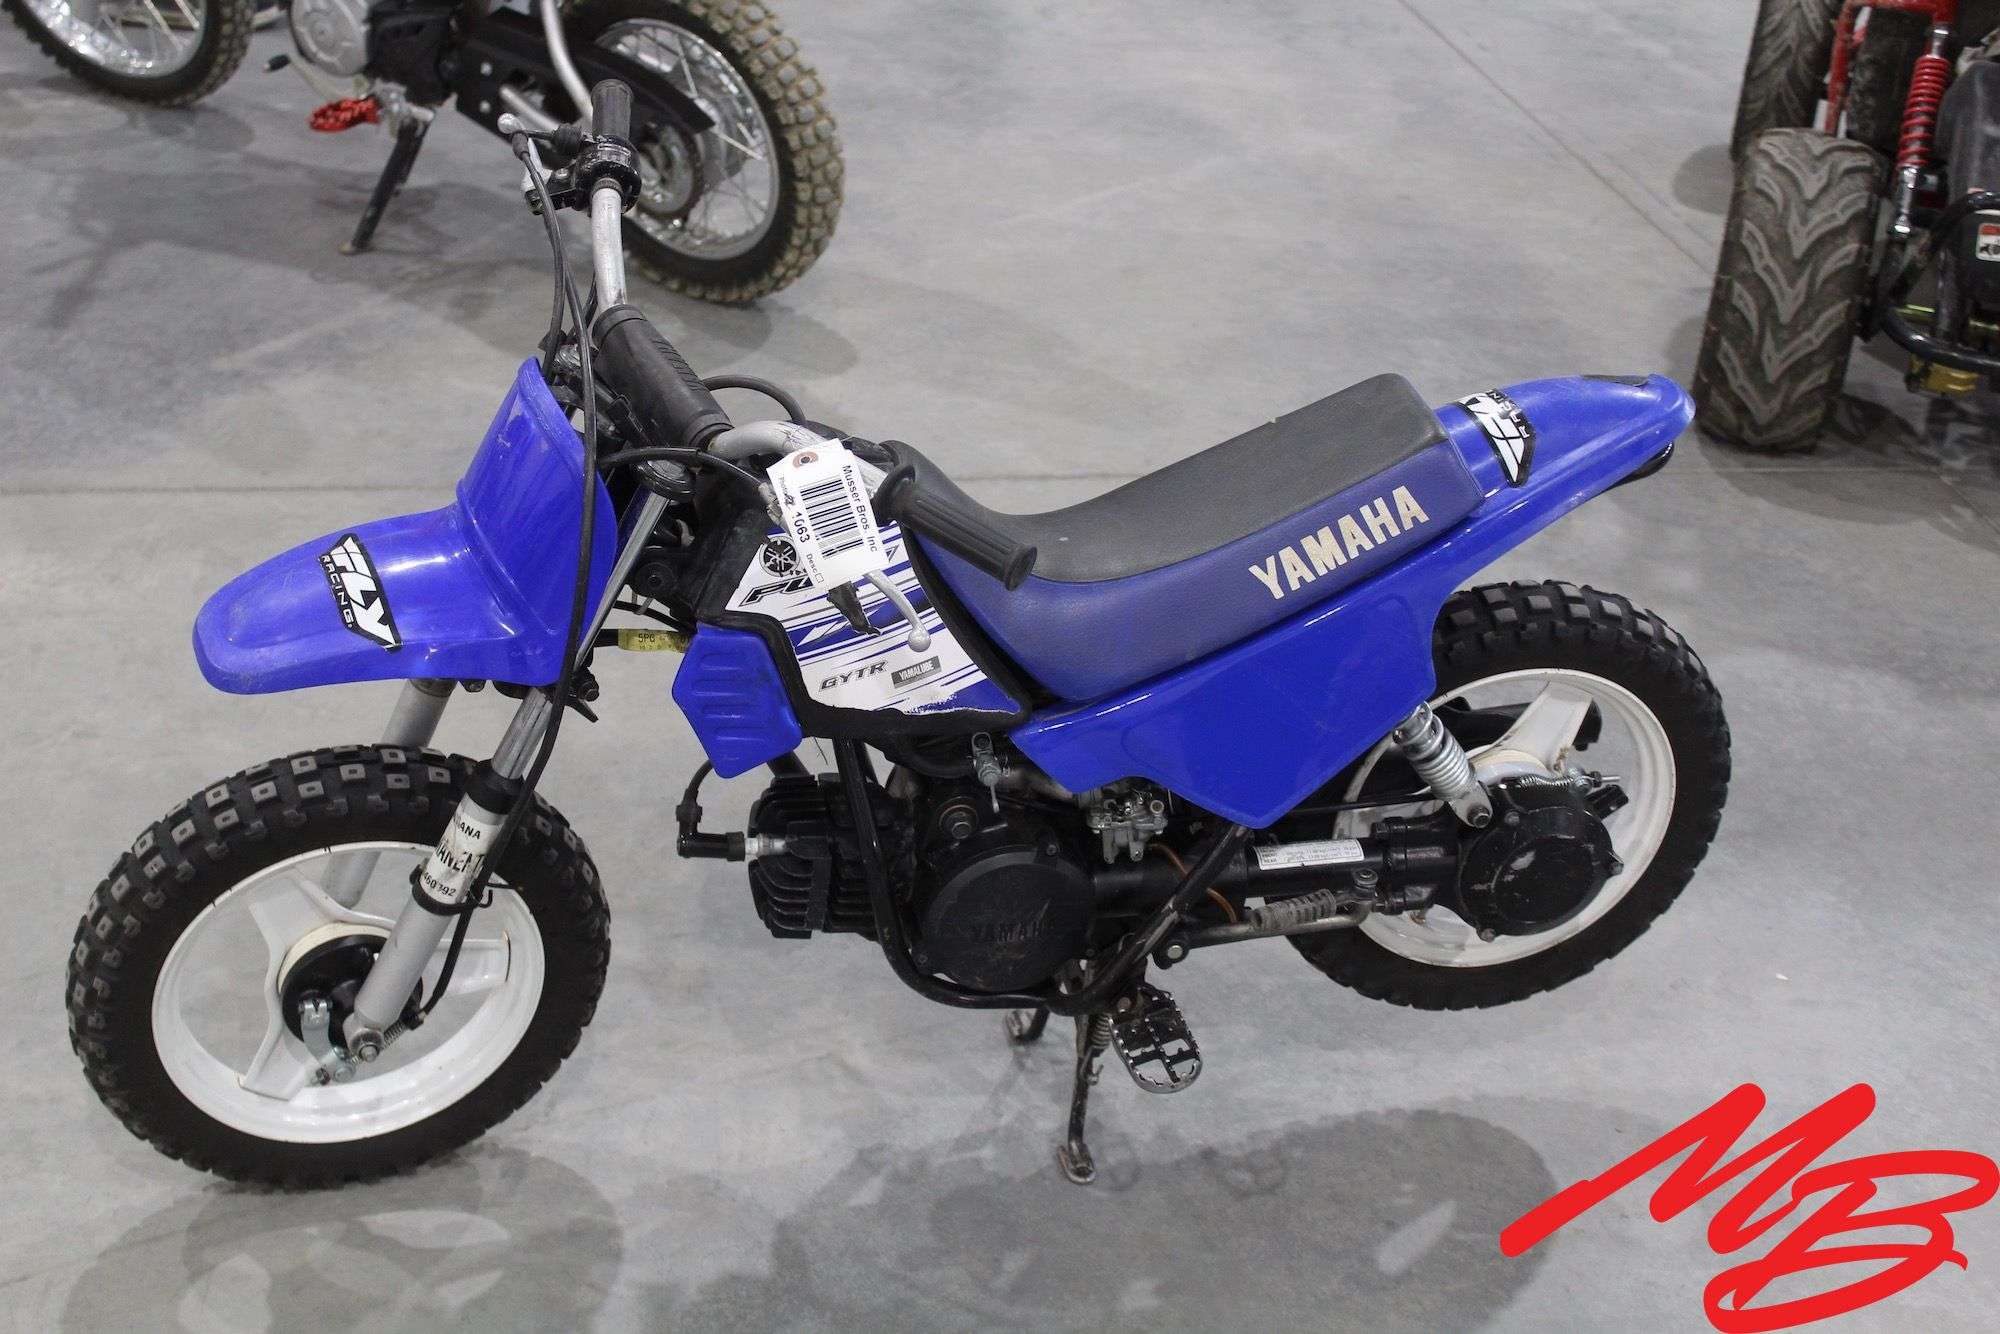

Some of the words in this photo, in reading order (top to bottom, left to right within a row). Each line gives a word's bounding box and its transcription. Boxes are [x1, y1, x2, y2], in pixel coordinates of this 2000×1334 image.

[793, 511, 810, 543] 1063
[806, 553, 818, 574] Desc
[842, 465, 860, 502] Musser
[867, 536, 877, 552] Inc
[1248, 485, 1430, 600] YAMAHA
[319, 554, 354, 625] RACING
[820, 661, 887, 691] GYTR
[899, 660, 934, 680] YAMALUBE
